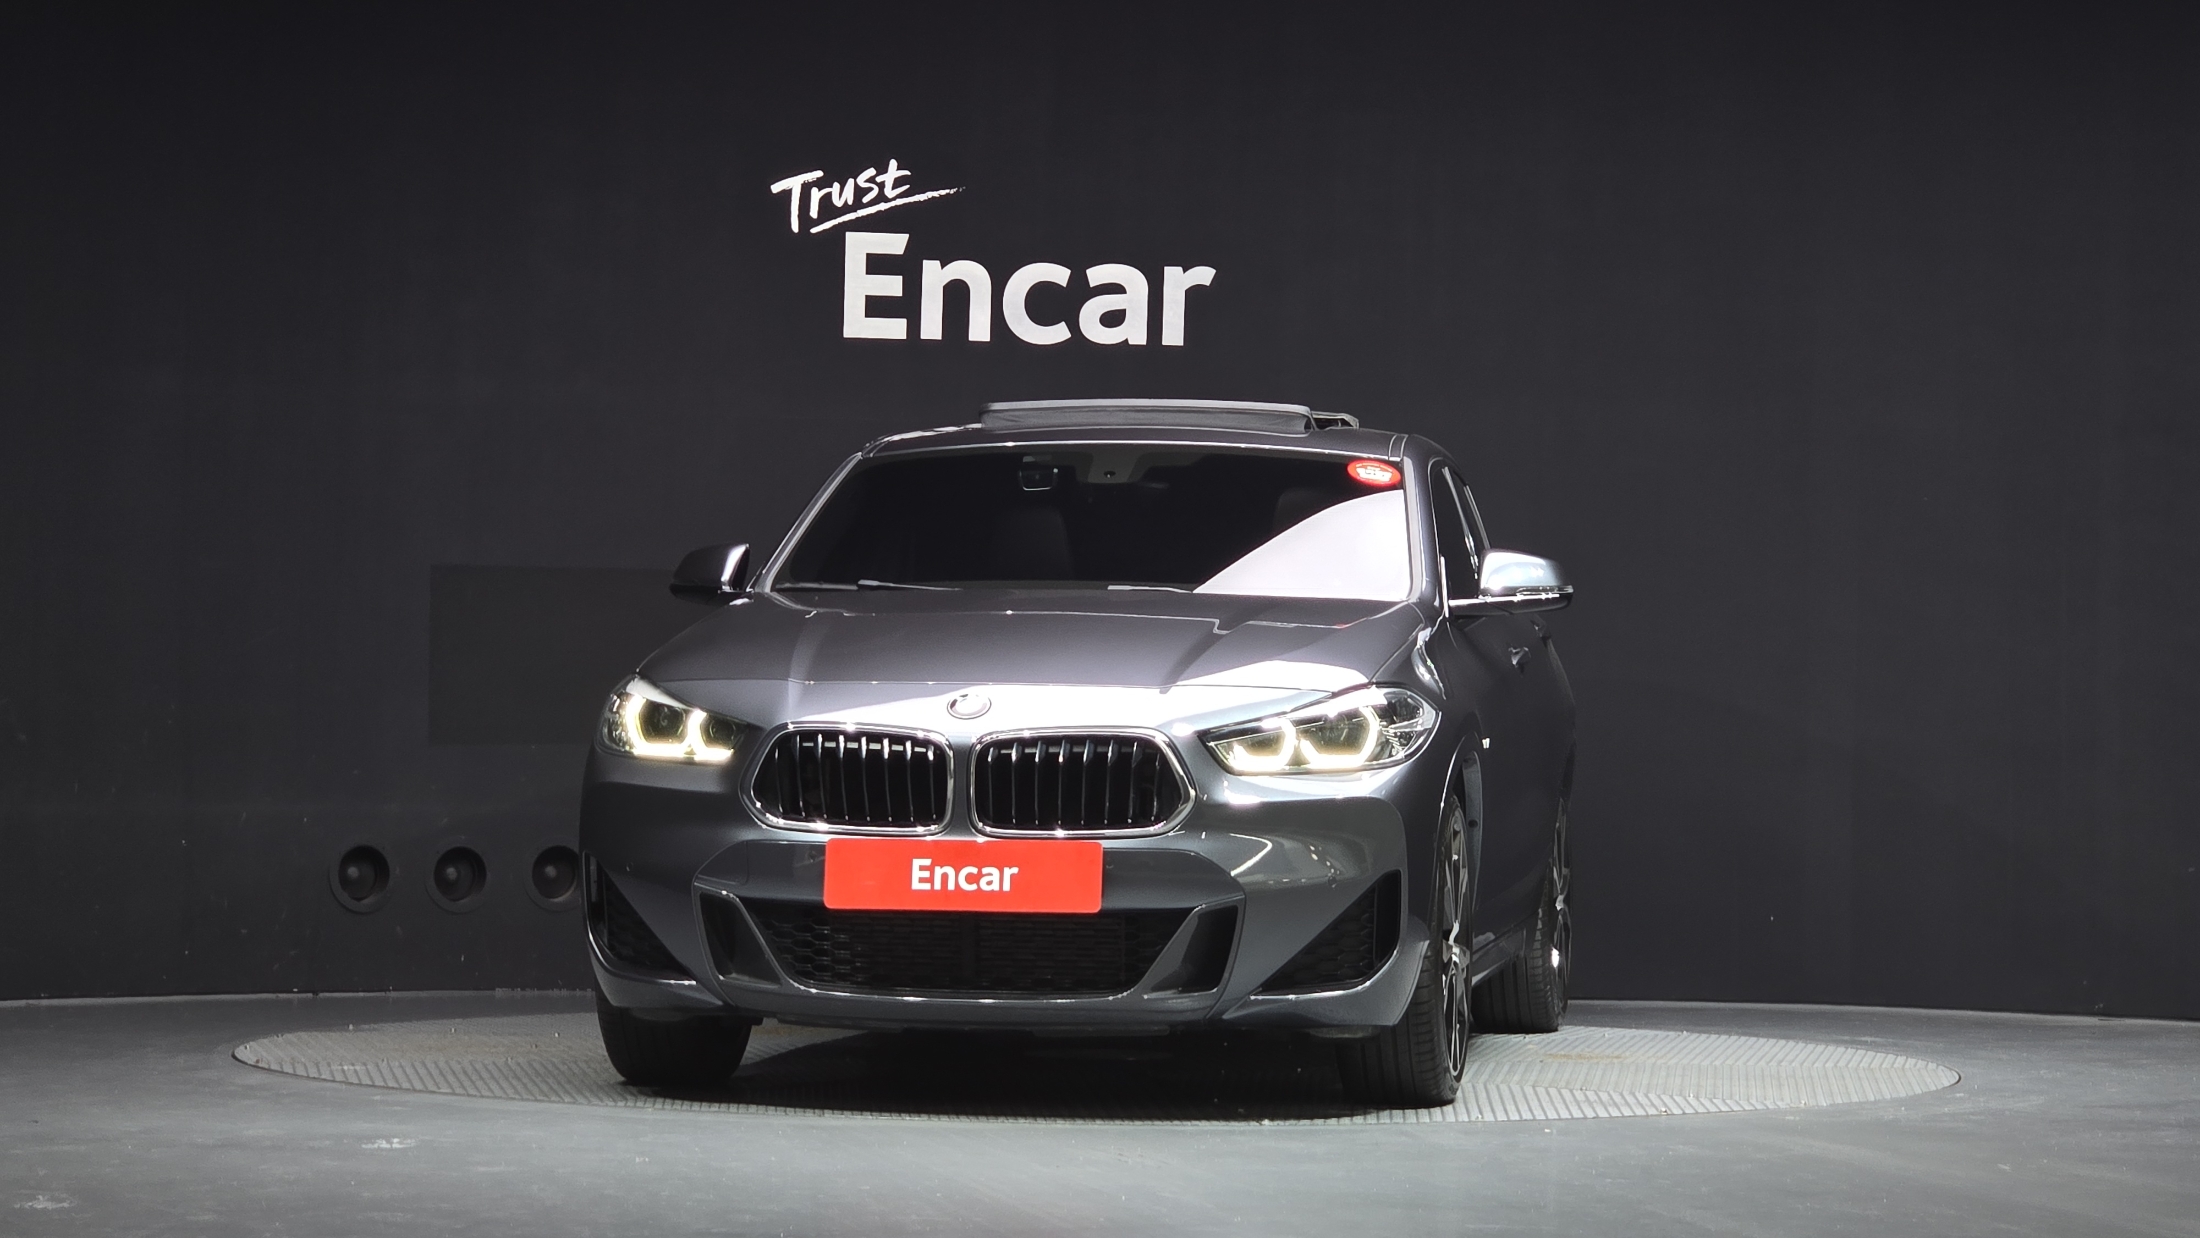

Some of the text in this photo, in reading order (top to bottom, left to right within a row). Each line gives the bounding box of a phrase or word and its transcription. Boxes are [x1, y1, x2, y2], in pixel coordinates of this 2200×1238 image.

[770, 158, 913, 234] Trust
[842, 231, 1217, 347] Encar
[911, 858, 1019, 892] Encar
